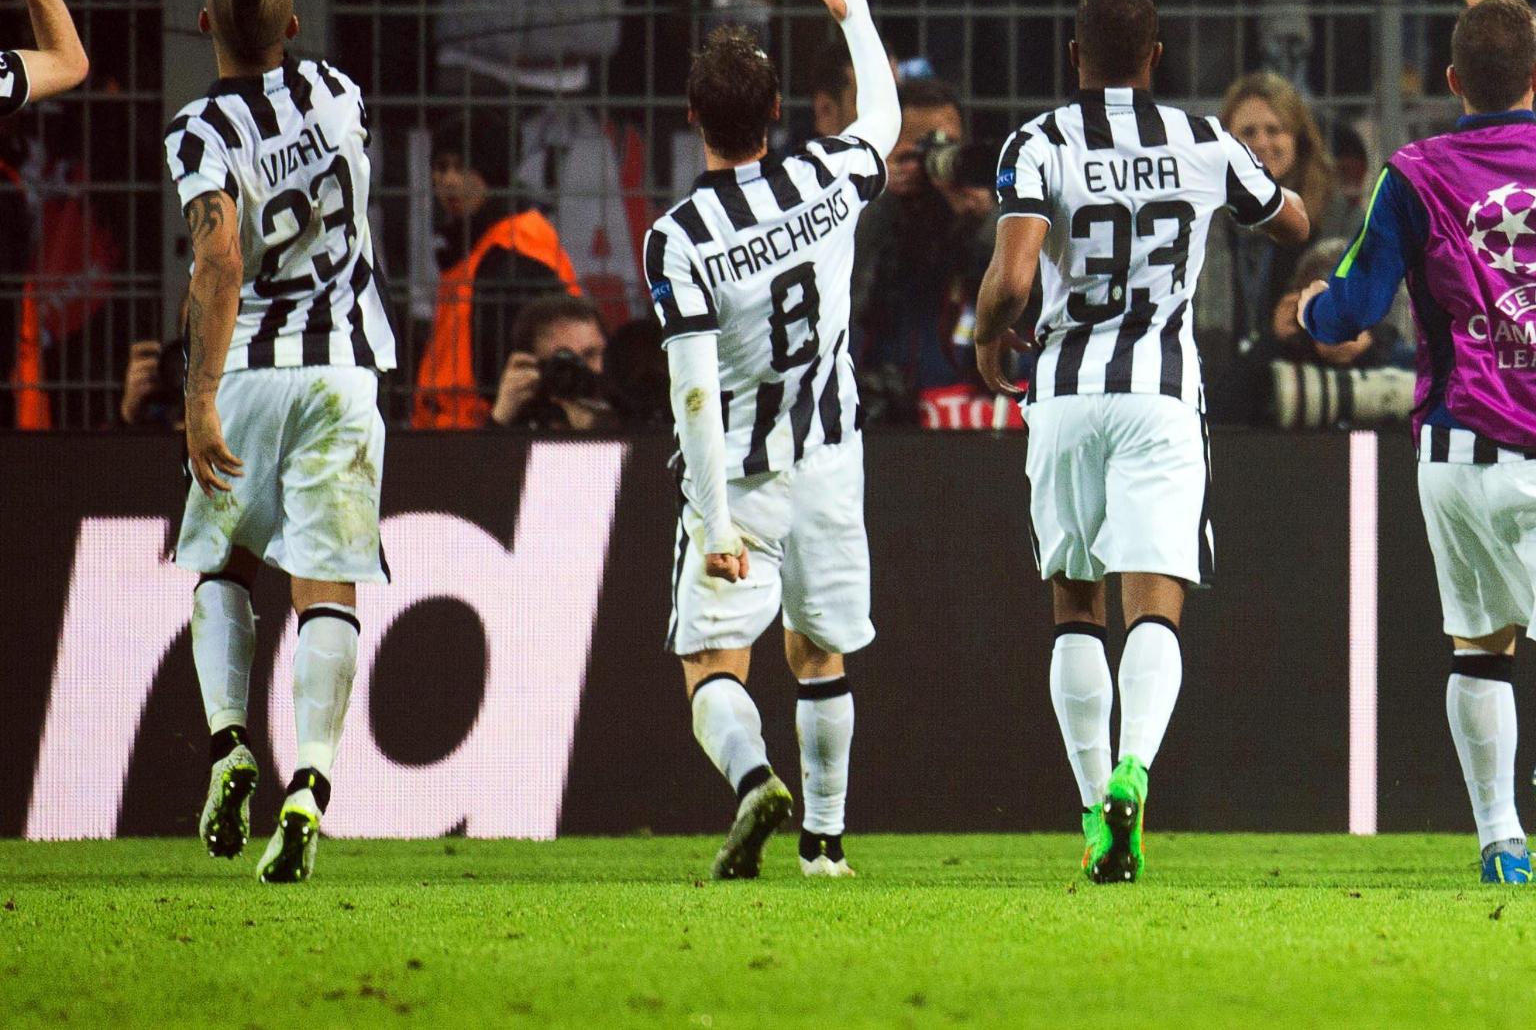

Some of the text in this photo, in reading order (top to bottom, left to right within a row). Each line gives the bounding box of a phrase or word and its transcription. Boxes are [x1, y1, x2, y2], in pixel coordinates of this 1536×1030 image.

[253, 153, 357, 299] 23
[1084, 156, 1181, 192] EVRA
[704, 187, 849, 288] MARCHISIO
[768, 260, 821, 374] 8
